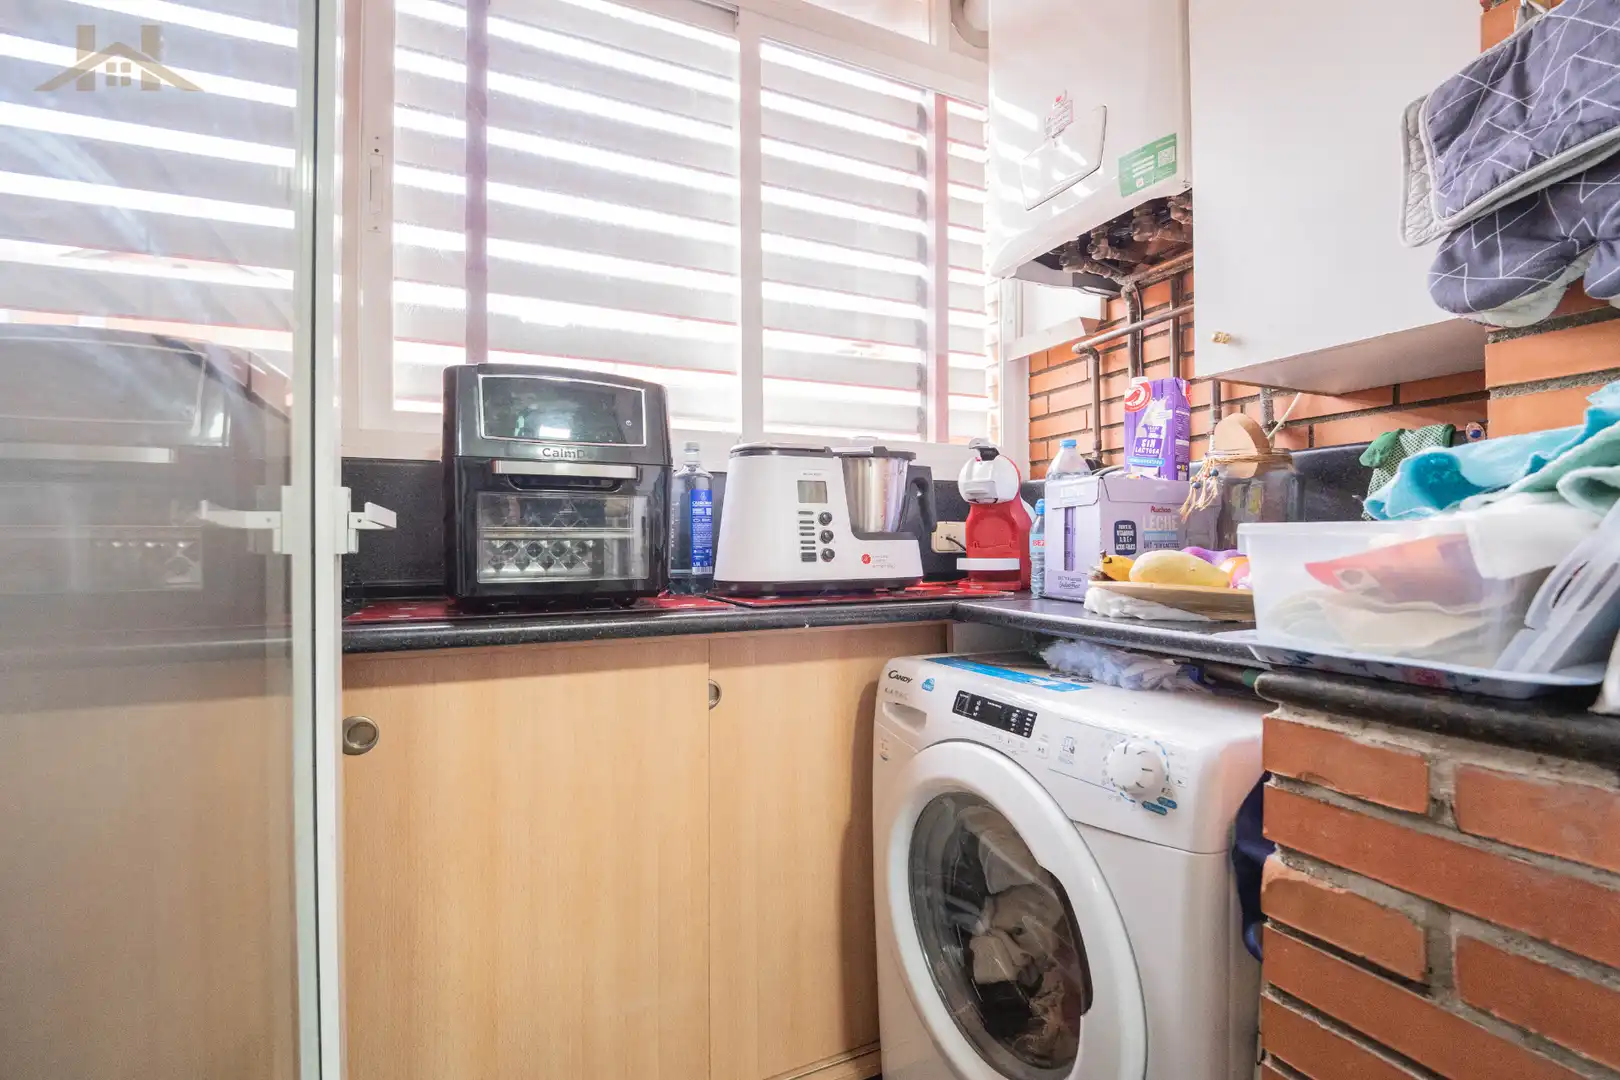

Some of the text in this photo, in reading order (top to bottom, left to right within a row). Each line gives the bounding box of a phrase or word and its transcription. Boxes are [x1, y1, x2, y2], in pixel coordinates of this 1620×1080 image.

[1141, 439, 1156, 448] SIN
[1135, 446, 1160, 454] LACTOSA
[1143, 515, 1178, 530] LECHE
